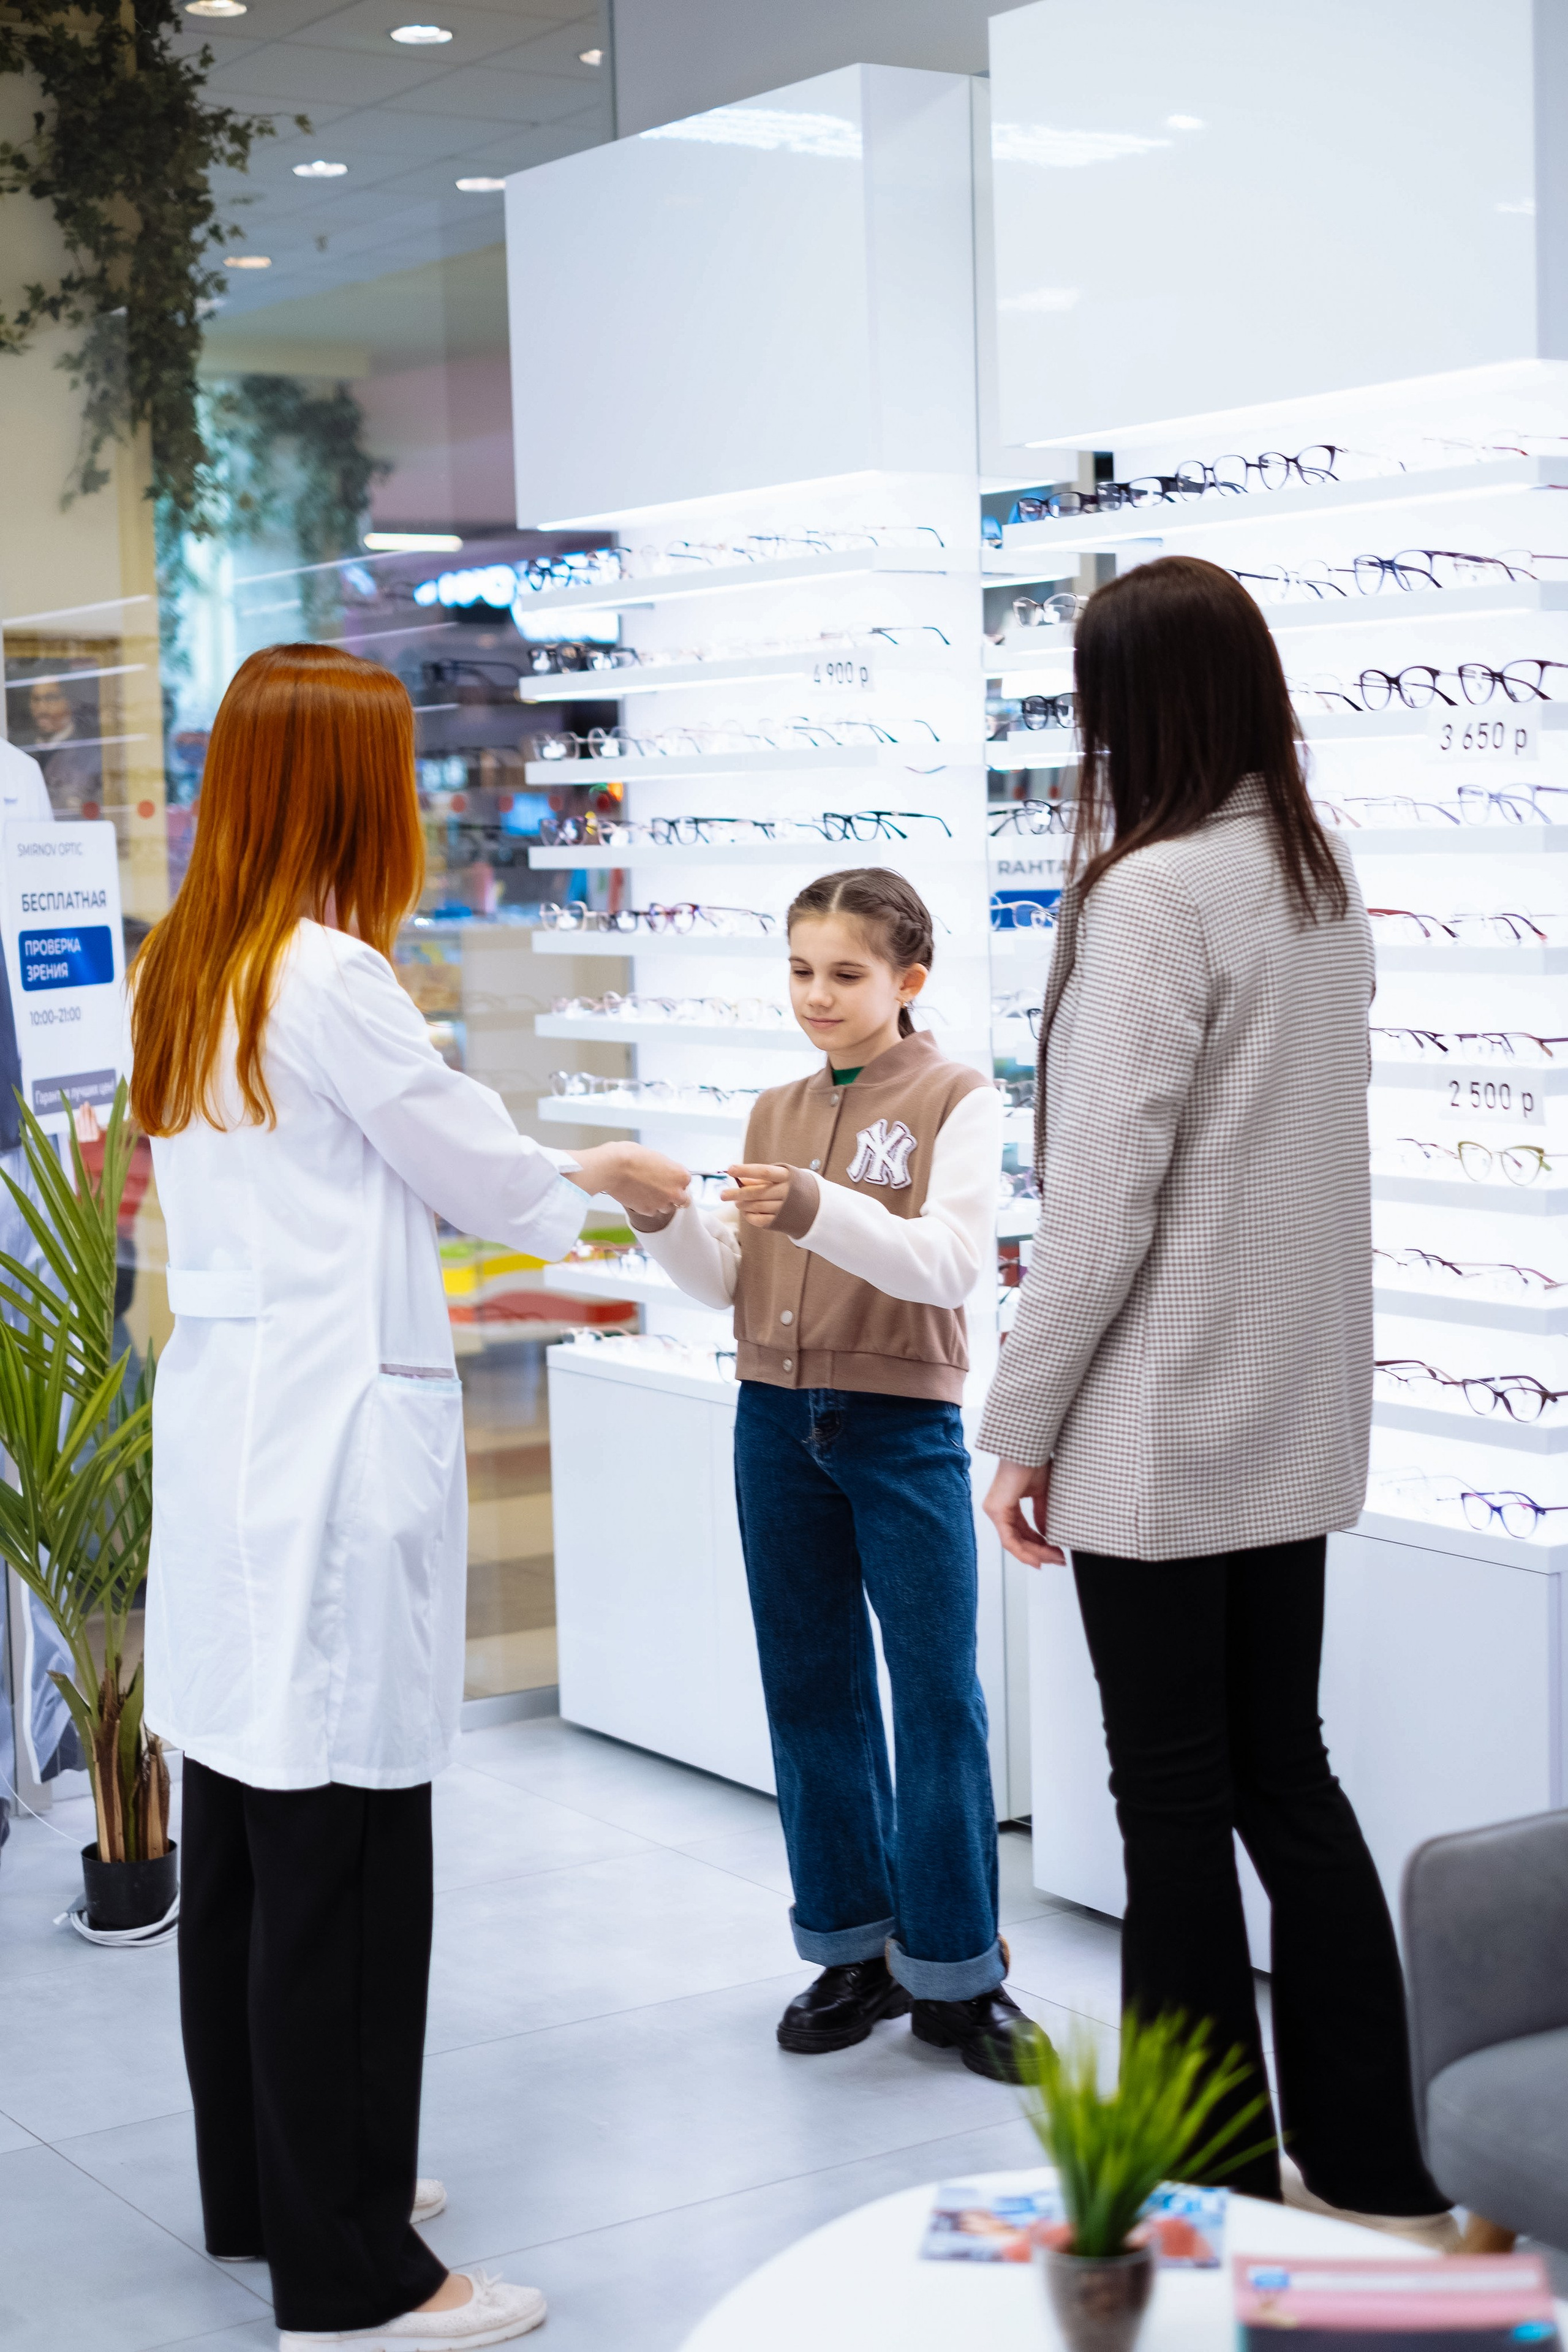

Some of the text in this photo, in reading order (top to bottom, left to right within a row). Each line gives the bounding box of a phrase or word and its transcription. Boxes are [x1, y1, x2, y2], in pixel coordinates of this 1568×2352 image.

[827, 662, 853, 684] 900
[1441, 724, 1452, 750] 3
[1463, 722, 1504, 750] 650
[17, 842, 83, 857] SMIRNOV OPTIC
[22, 890, 107, 912] БЕСПЛАТНАЯ
[24, 938, 81, 957] ПРОВЕРКА
[26, 962, 69, 981] ЗРЕНИЯ
[1449, 1080, 1460, 1107] 2
[1471, 1082, 1511, 1110] 500
[846, 1118, 918, 1189] NY
